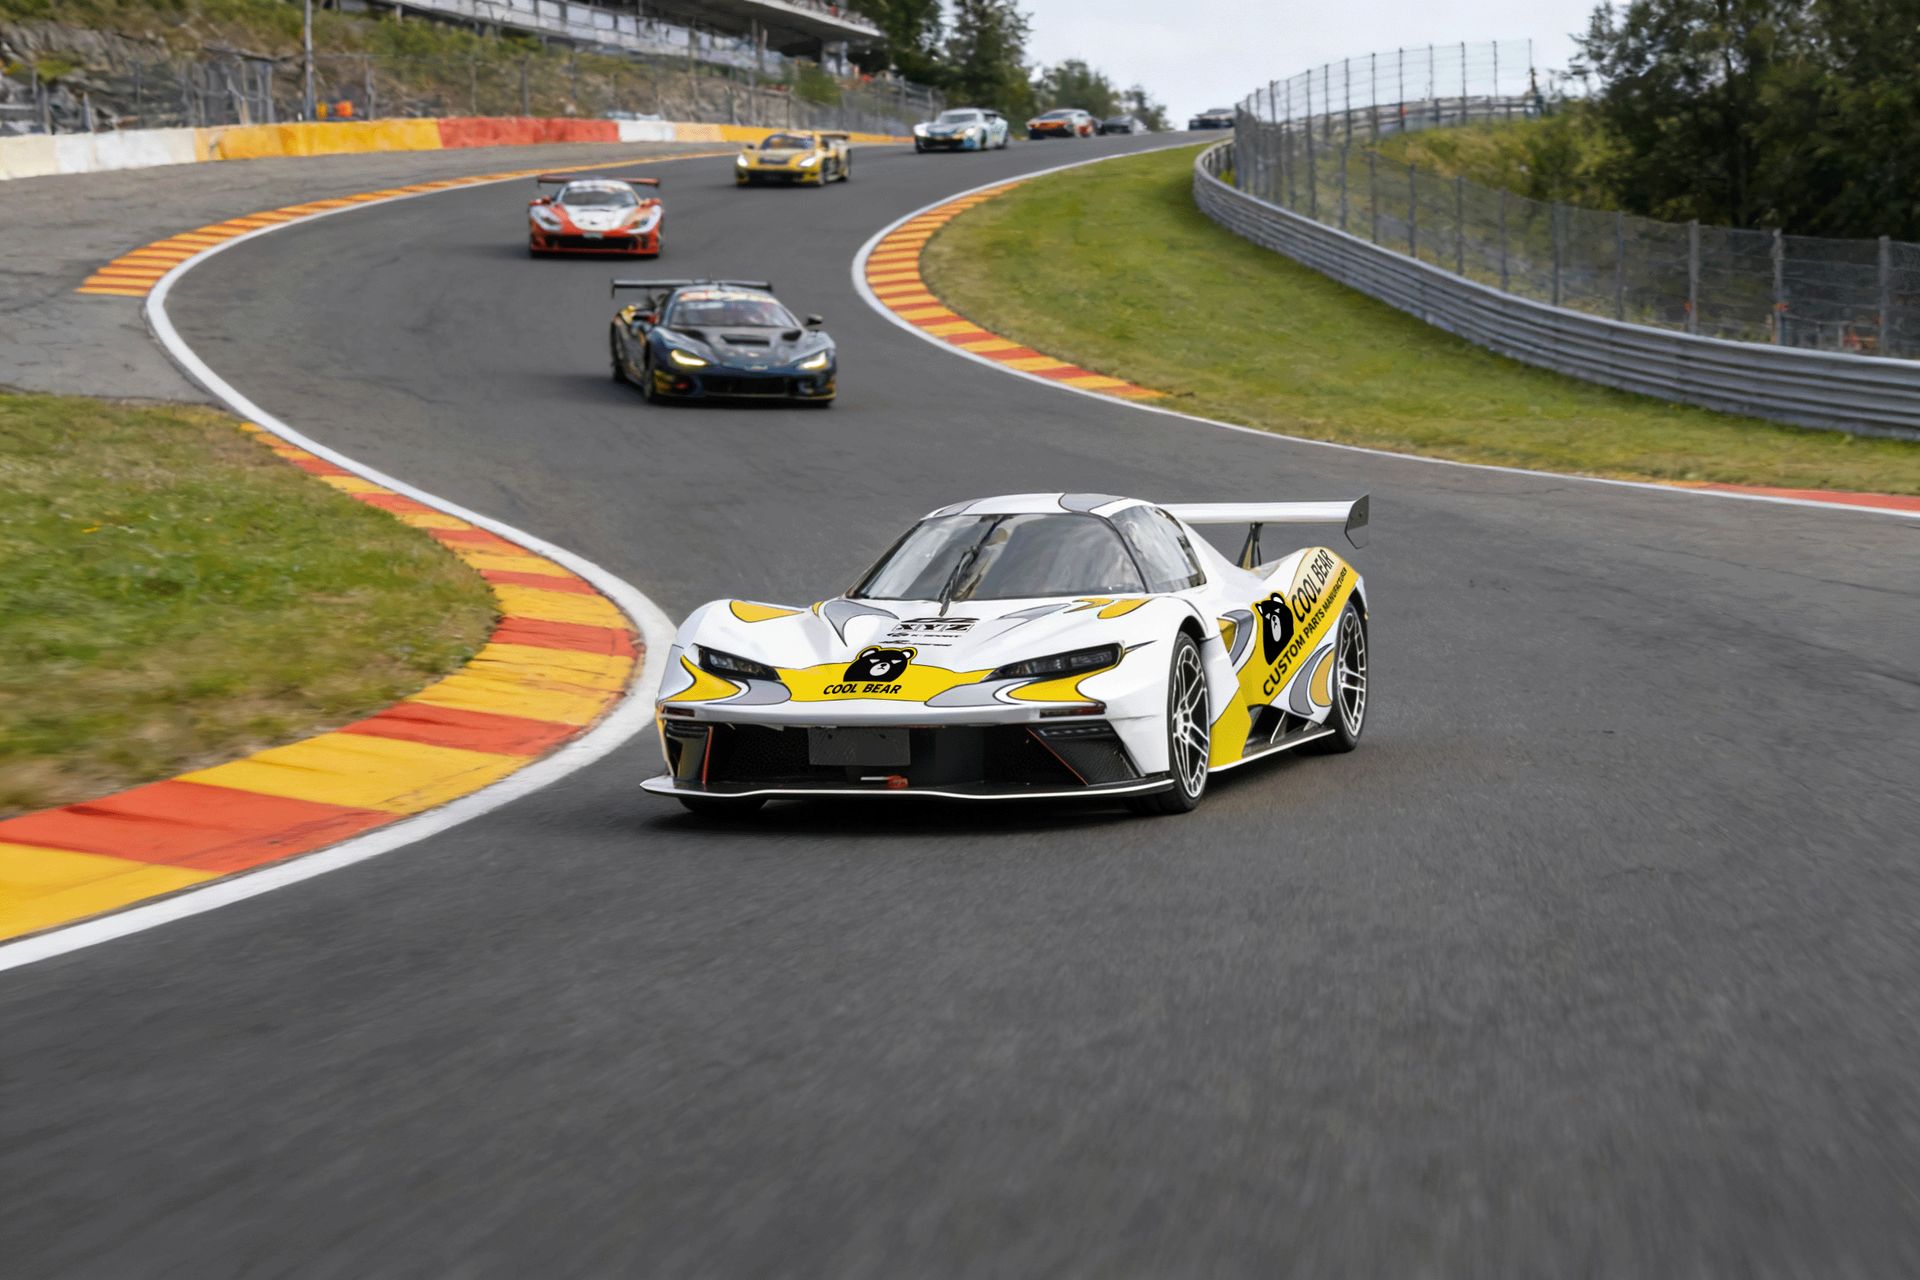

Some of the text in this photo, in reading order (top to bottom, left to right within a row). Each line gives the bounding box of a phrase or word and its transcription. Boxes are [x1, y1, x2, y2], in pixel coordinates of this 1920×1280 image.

[1292, 549, 1335, 623] COOL BEAR
[1263, 567, 1348, 696] CUSTOM PARTS MANUFACTURER
[823, 683, 902, 695] COOL BEAR
